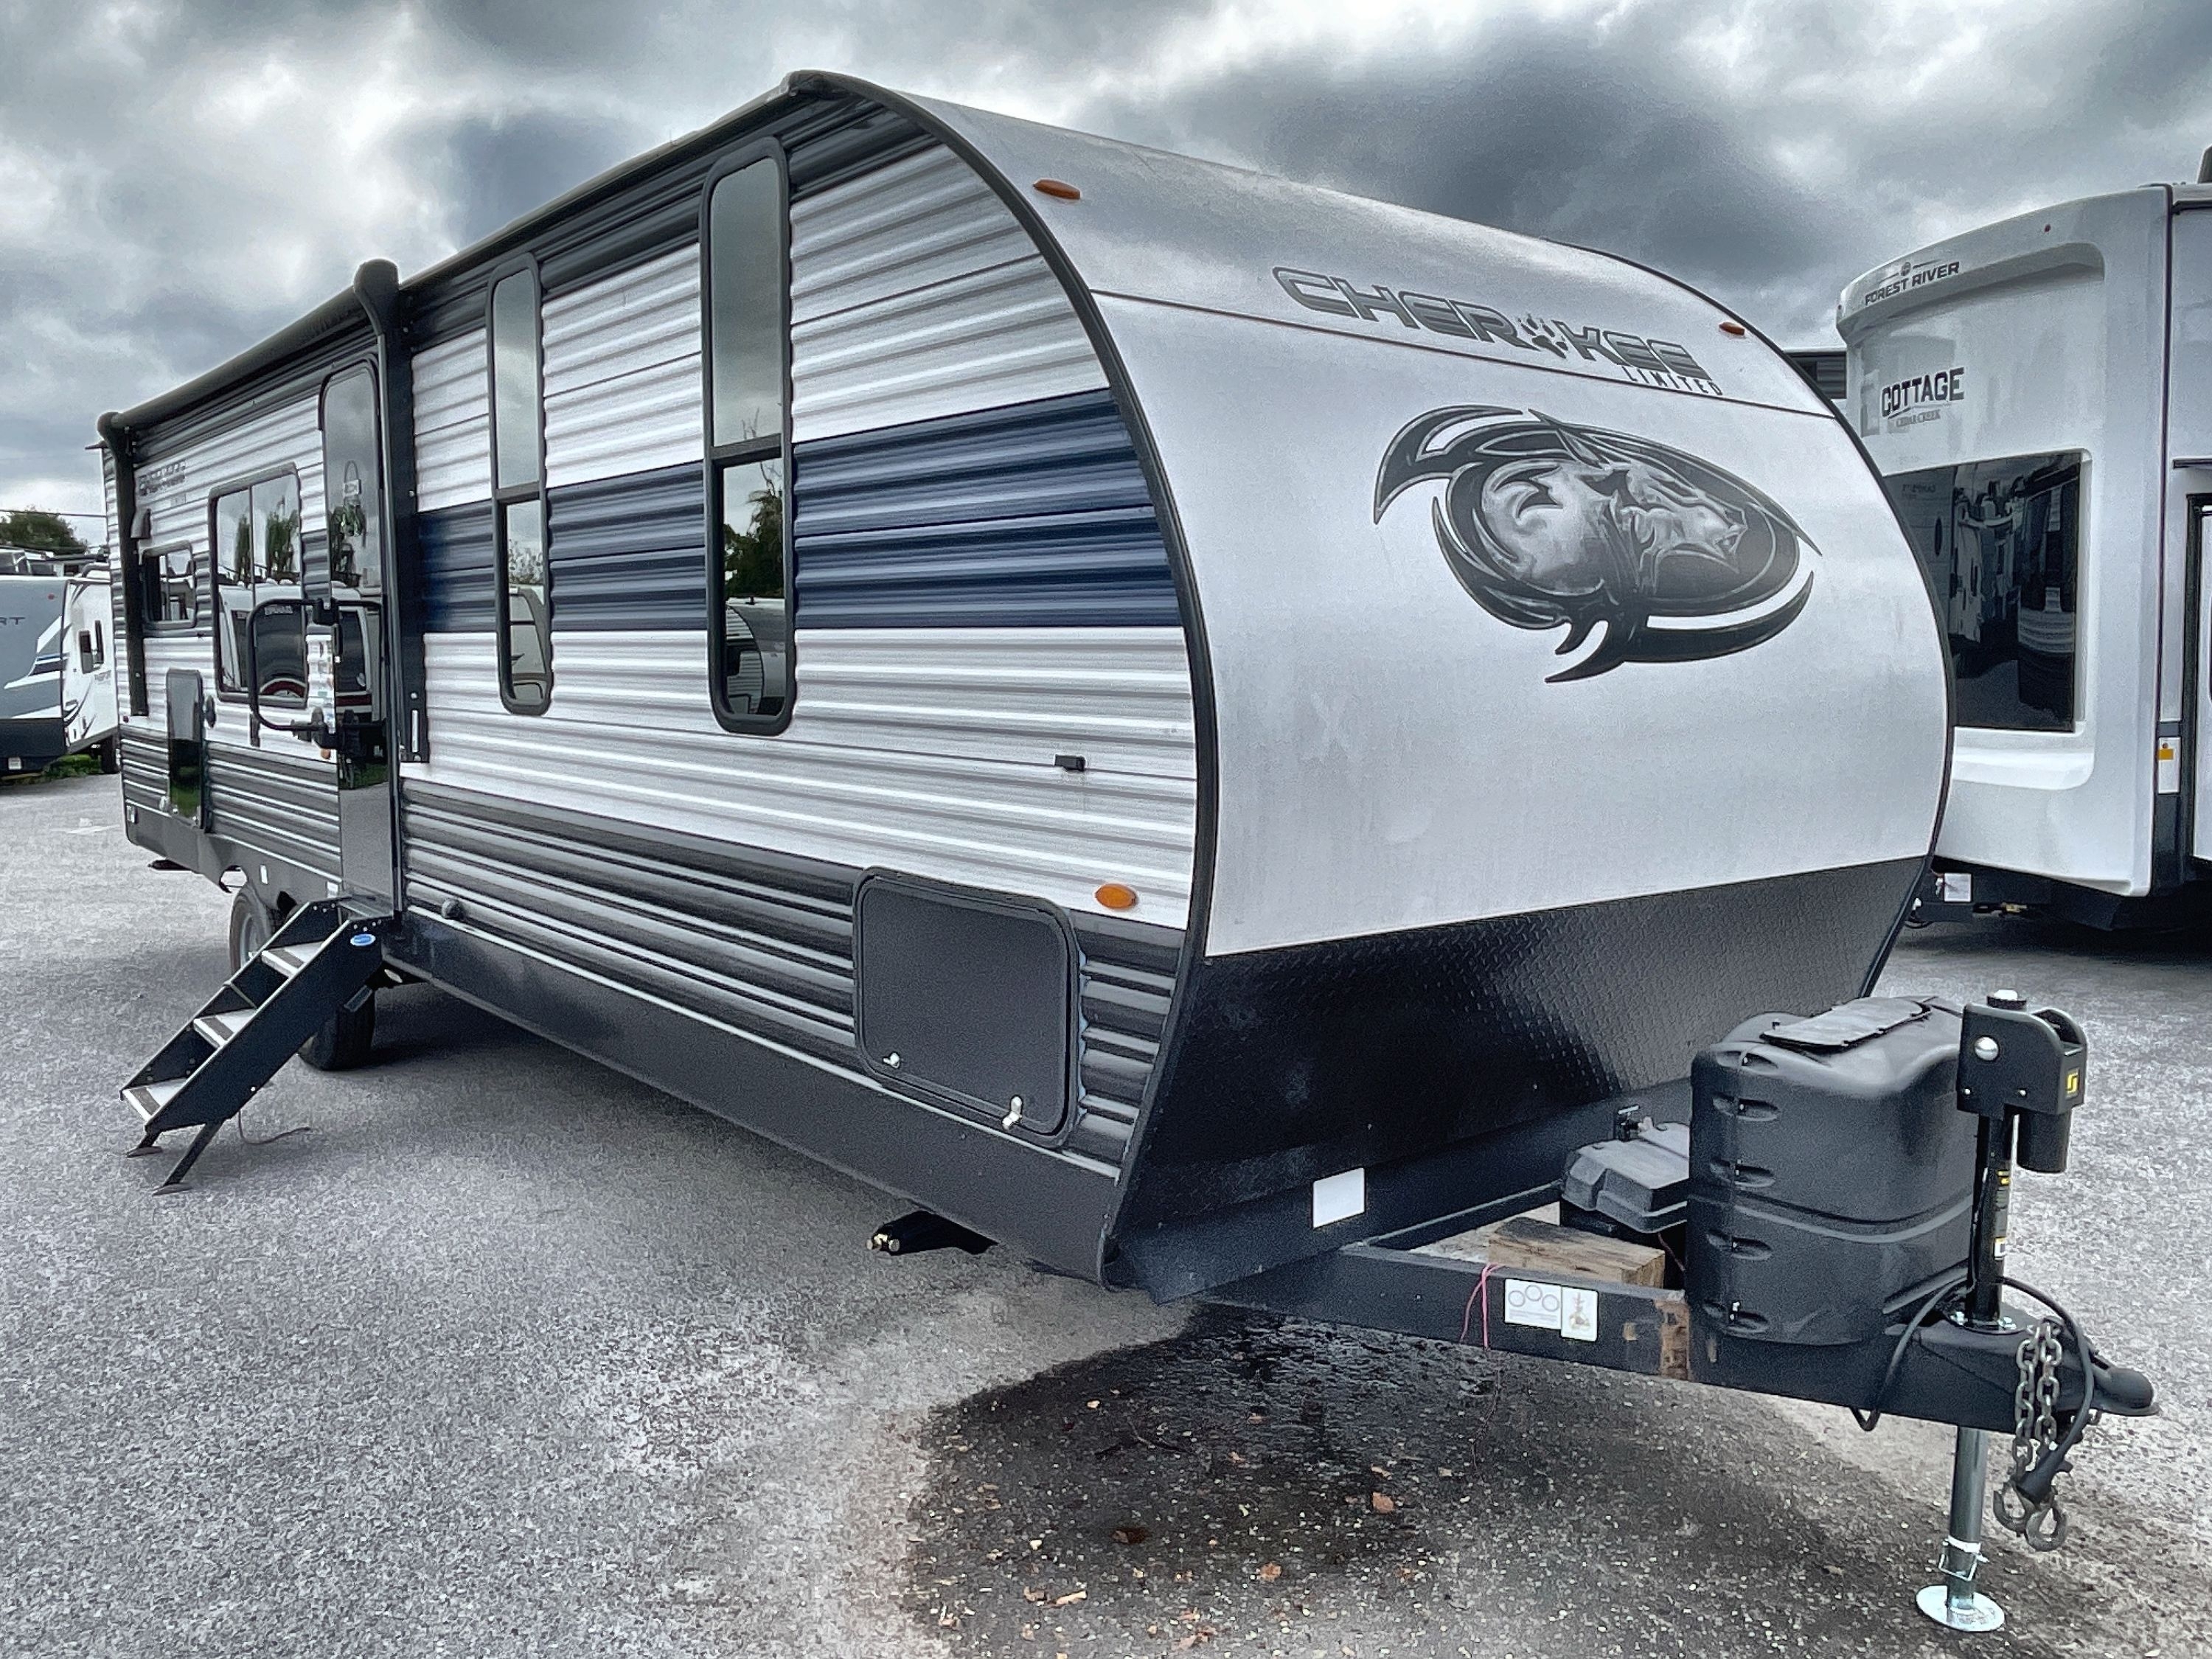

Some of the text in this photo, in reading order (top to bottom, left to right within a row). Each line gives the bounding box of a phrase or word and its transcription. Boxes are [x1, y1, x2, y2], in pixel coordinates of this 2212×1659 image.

[1865, 261, 1960, 306] FOREST RIVER
[1622, 366, 1723, 396] LIMITED
[1882, 366, 1965, 418] COTTAGE
